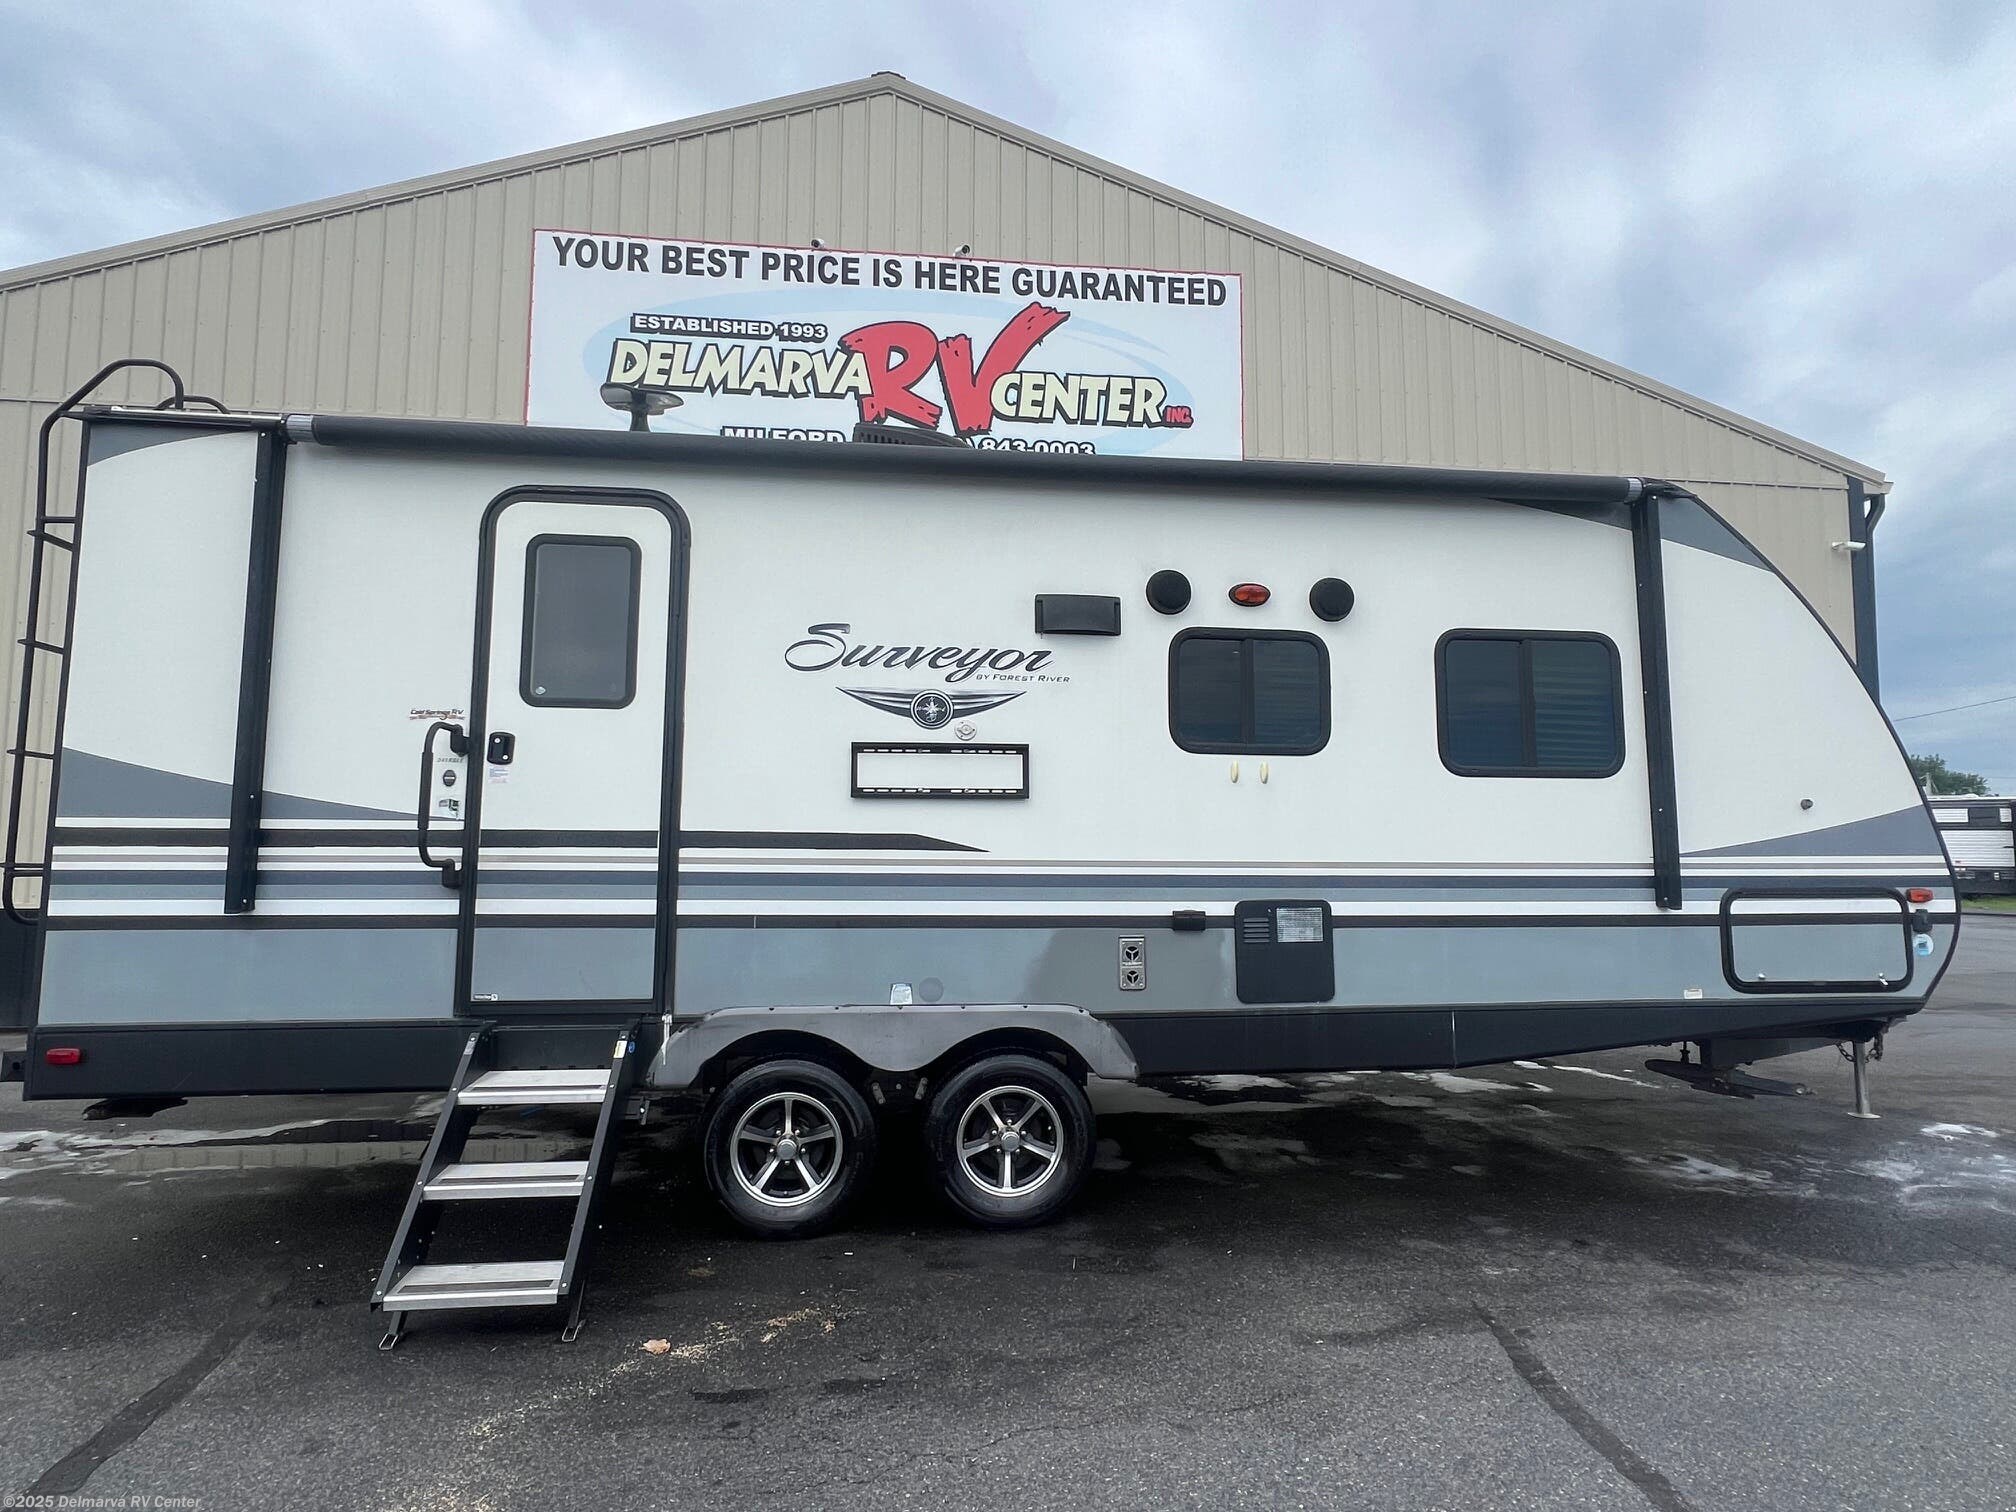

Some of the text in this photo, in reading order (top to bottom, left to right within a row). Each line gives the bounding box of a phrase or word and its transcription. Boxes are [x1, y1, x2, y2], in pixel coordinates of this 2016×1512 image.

[552, 236, 1227, 307] YOUR BEST PRICE IS HERE GUARANTEED
[632, 314, 828, 342] ESTABLISHED 1993
[608, 338, 874, 399] DELMARVA
[838, 301, 1071, 436] RV
[990, 371, 1169, 428] CENTER
[784, 623, 1055, 683] Surveyor
